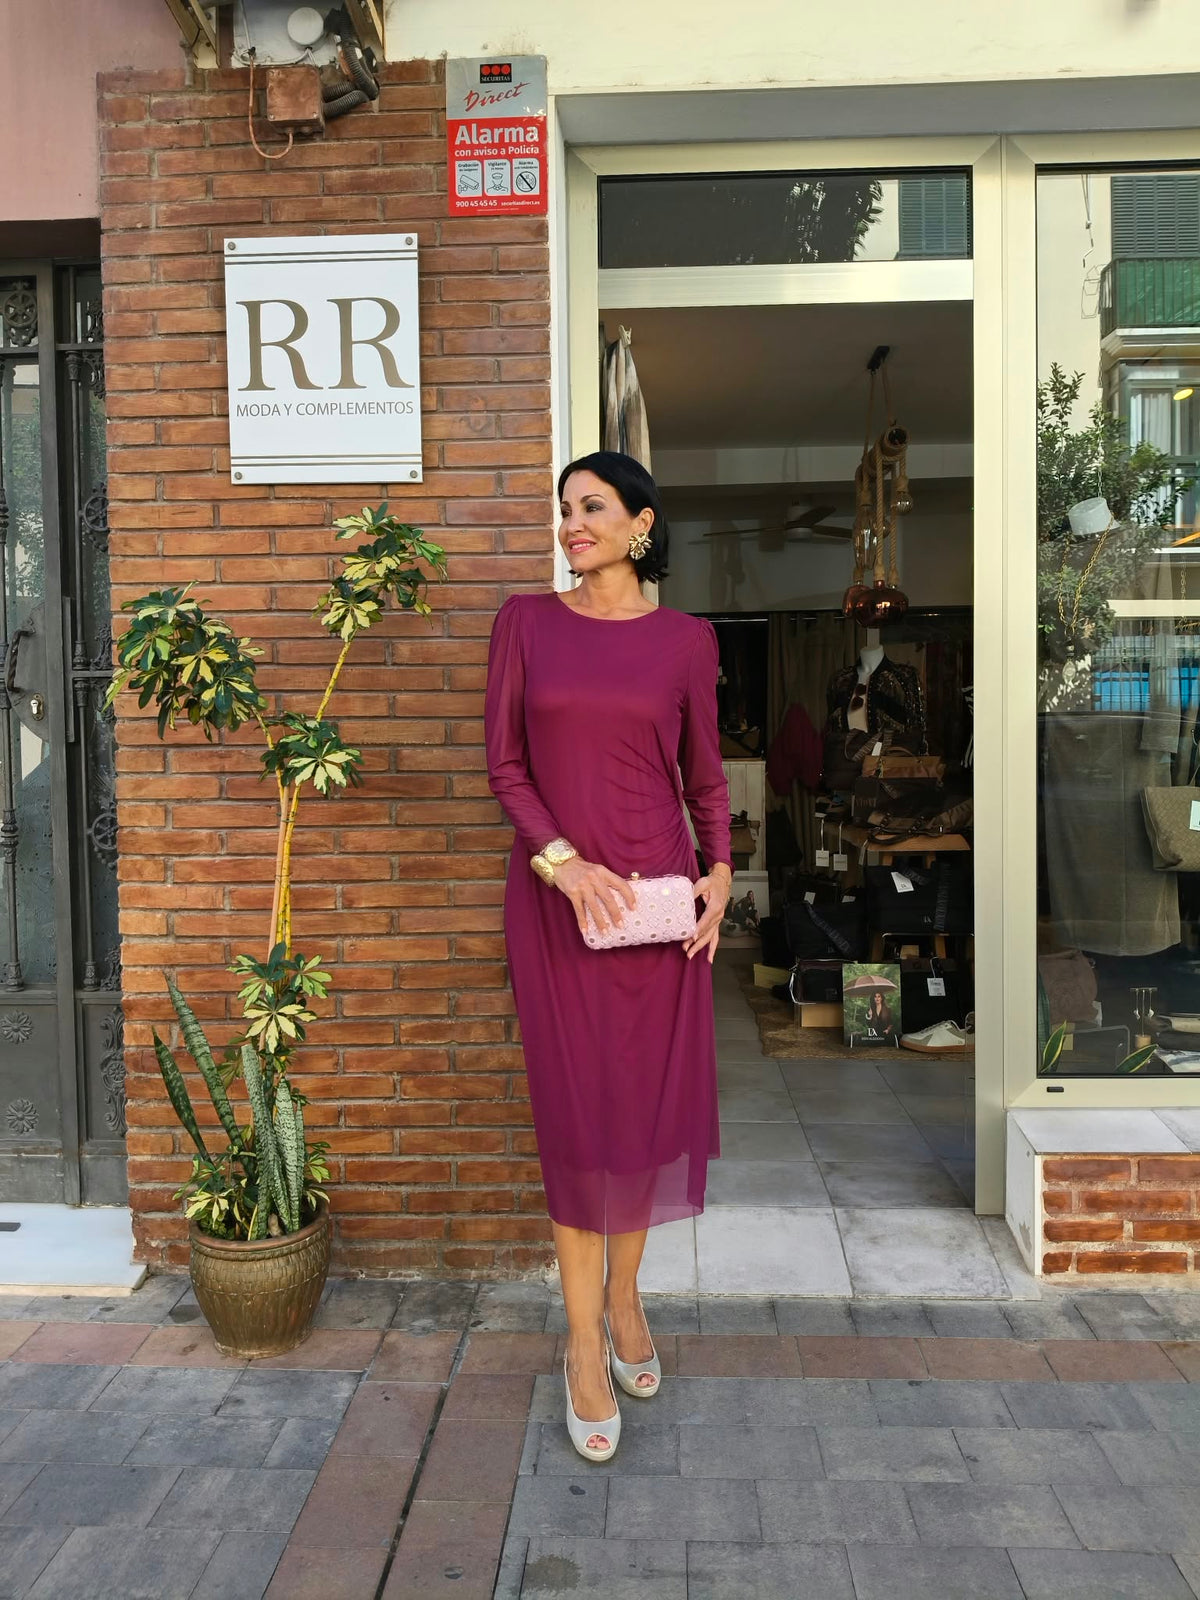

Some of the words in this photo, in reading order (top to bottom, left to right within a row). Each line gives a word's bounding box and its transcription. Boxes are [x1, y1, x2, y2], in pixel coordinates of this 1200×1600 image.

[464, 82, 532, 112] Direct
[455, 123, 539, 145] Alarma
[454, 149, 471, 157] con
[473, 146, 498, 156] aviso
[508, 144, 540, 155] Policía
[455, 200, 469, 208] 900
[235, 296, 416, 392] RR
[236, 403, 281, 417] MODA
[283, 403, 293, 416] Y
[296, 401, 414, 416] COMPLEMENTOS
